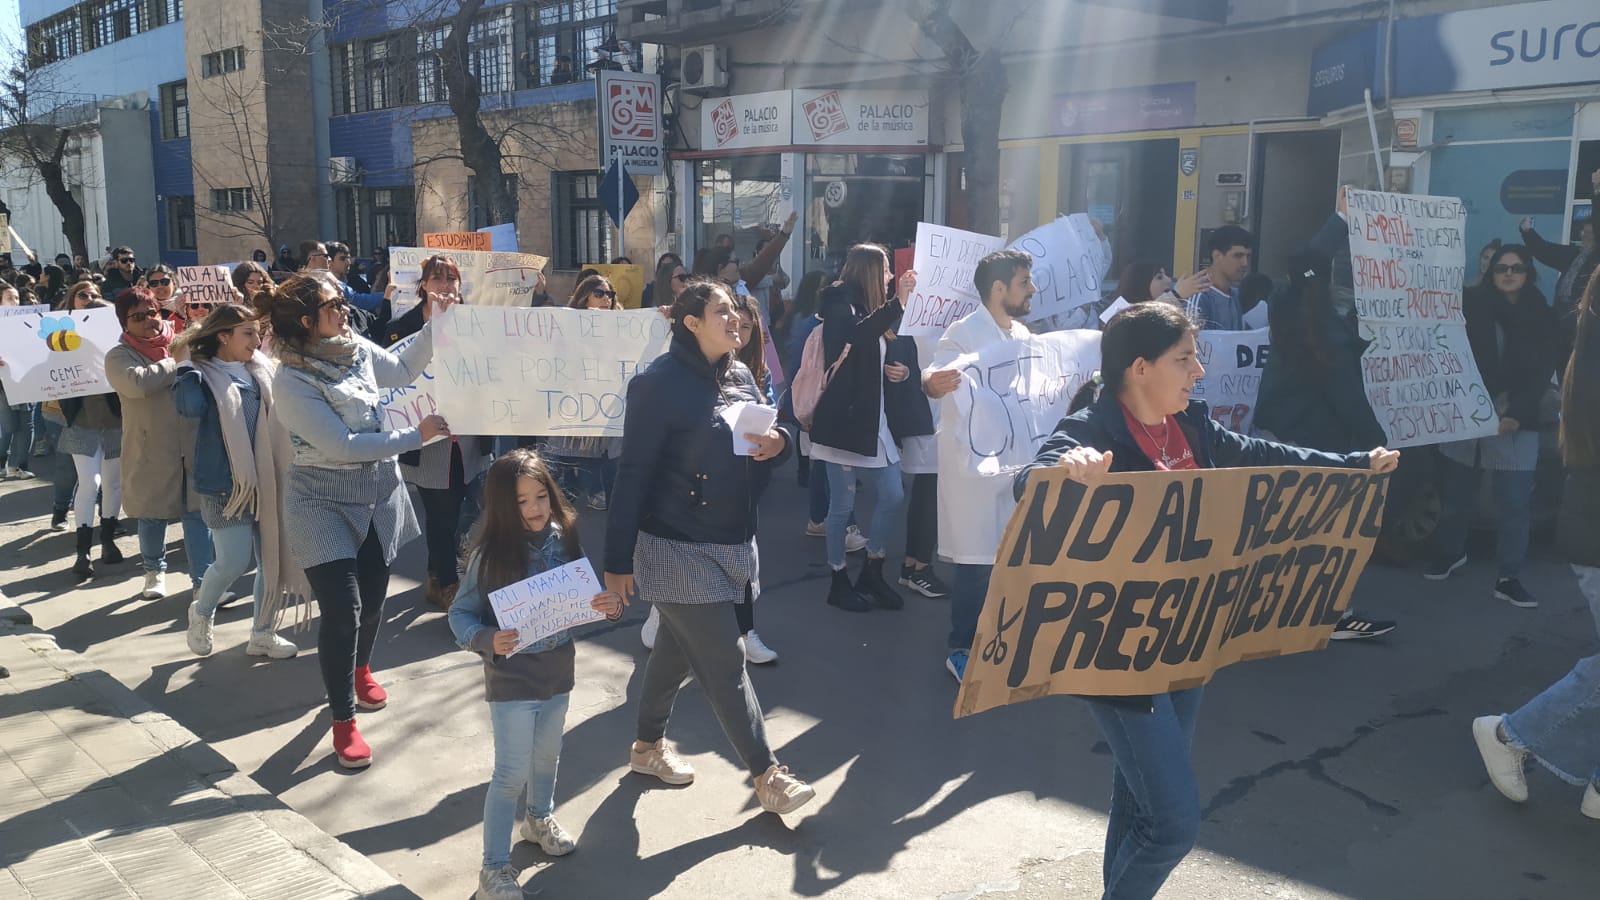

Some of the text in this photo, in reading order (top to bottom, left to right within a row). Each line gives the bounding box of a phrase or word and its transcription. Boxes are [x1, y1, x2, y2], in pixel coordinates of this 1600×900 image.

[744, 106, 778, 122] PALACIO
[859, 104, 914, 119] PALACIO
[743, 122, 779, 135] de la música
[858, 120, 914, 131] de la música
[610, 144, 659, 158] PALACIO
[1349, 215, 1362, 236] LA
[1414, 227, 1426, 249] TE
[1427, 227, 1462, 249] CUESTA
[396, 250, 418, 266] NO
[929, 233, 952, 262] EN
[180, 267, 228, 283] NO A LA
[928, 264, 949, 288] DE
[1408, 264, 1415, 287] Y
[1416, 263, 1465, 292] CANTAMOS
[181, 284, 236, 303] REFORMA
[1356, 298, 1368, 318] EN
[1392, 298, 1406, 318] DE
[1405, 287, 1463, 321] PROTESTA
[453, 306, 672, 343] LA LUCHA DE POCO
[1379, 326, 1392, 351] ES
[49, 363, 84, 383] CEMF
[443, 354, 505, 387] VALE
[520, 356, 576, 383] POR
[581, 357, 614, 383] EL
[1361, 352, 1439, 385] PREGUNTAMOS
[1437, 350, 1464, 377] BIEN
[1395, 383, 1419, 405] NOS
[1439, 379, 1467, 400] UNA
[489, 389, 626, 425] DE TODO
[1386, 401, 1466, 441] RESPUESTA
[1007, 470, 1390, 567] NO AL RECORTE
[493, 588, 519, 610] MI
[499, 588, 580, 630] LUCHANDO
[1006, 544, 1357, 688] PRESUPUESTAL
